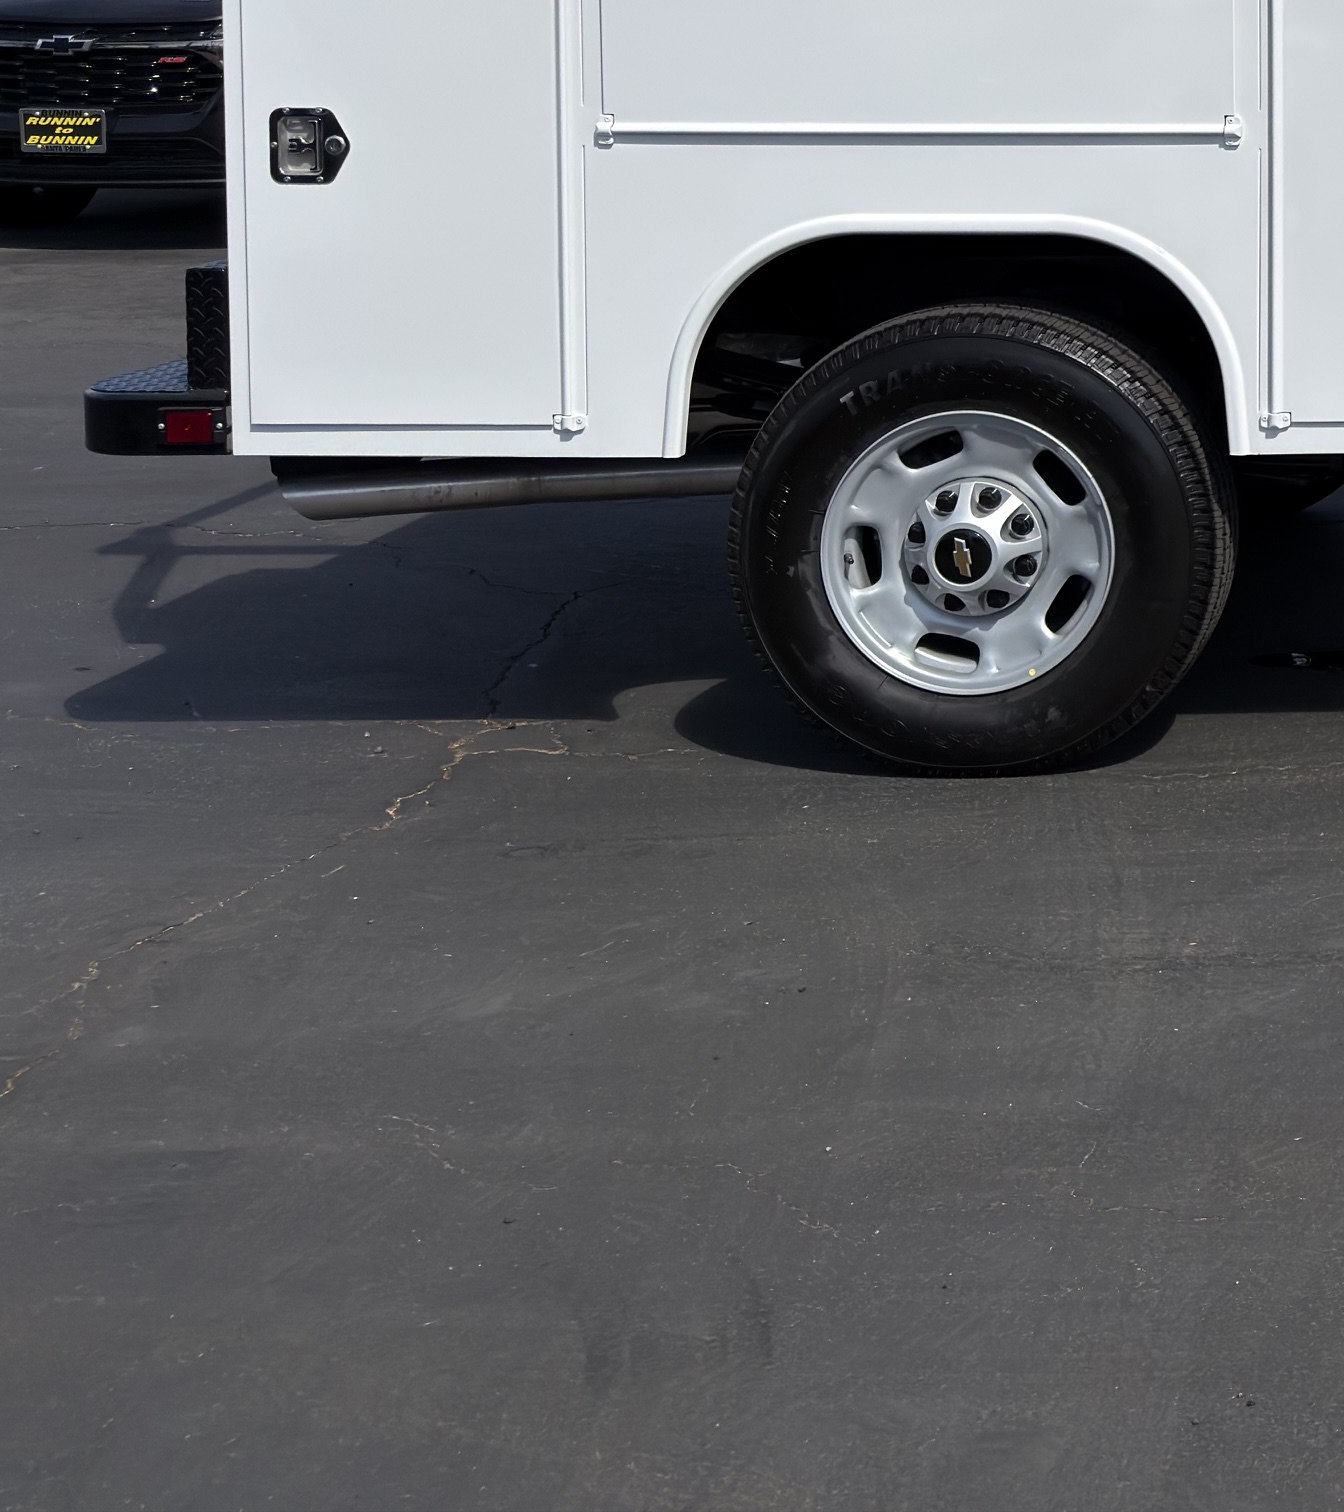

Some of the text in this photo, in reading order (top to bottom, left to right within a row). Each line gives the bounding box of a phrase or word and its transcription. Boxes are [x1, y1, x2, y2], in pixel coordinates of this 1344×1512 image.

[25, 116, 101, 126] RUNNIN'
[54, 126, 74, 134] to
[26, 135, 99, 145] BUNNIN
